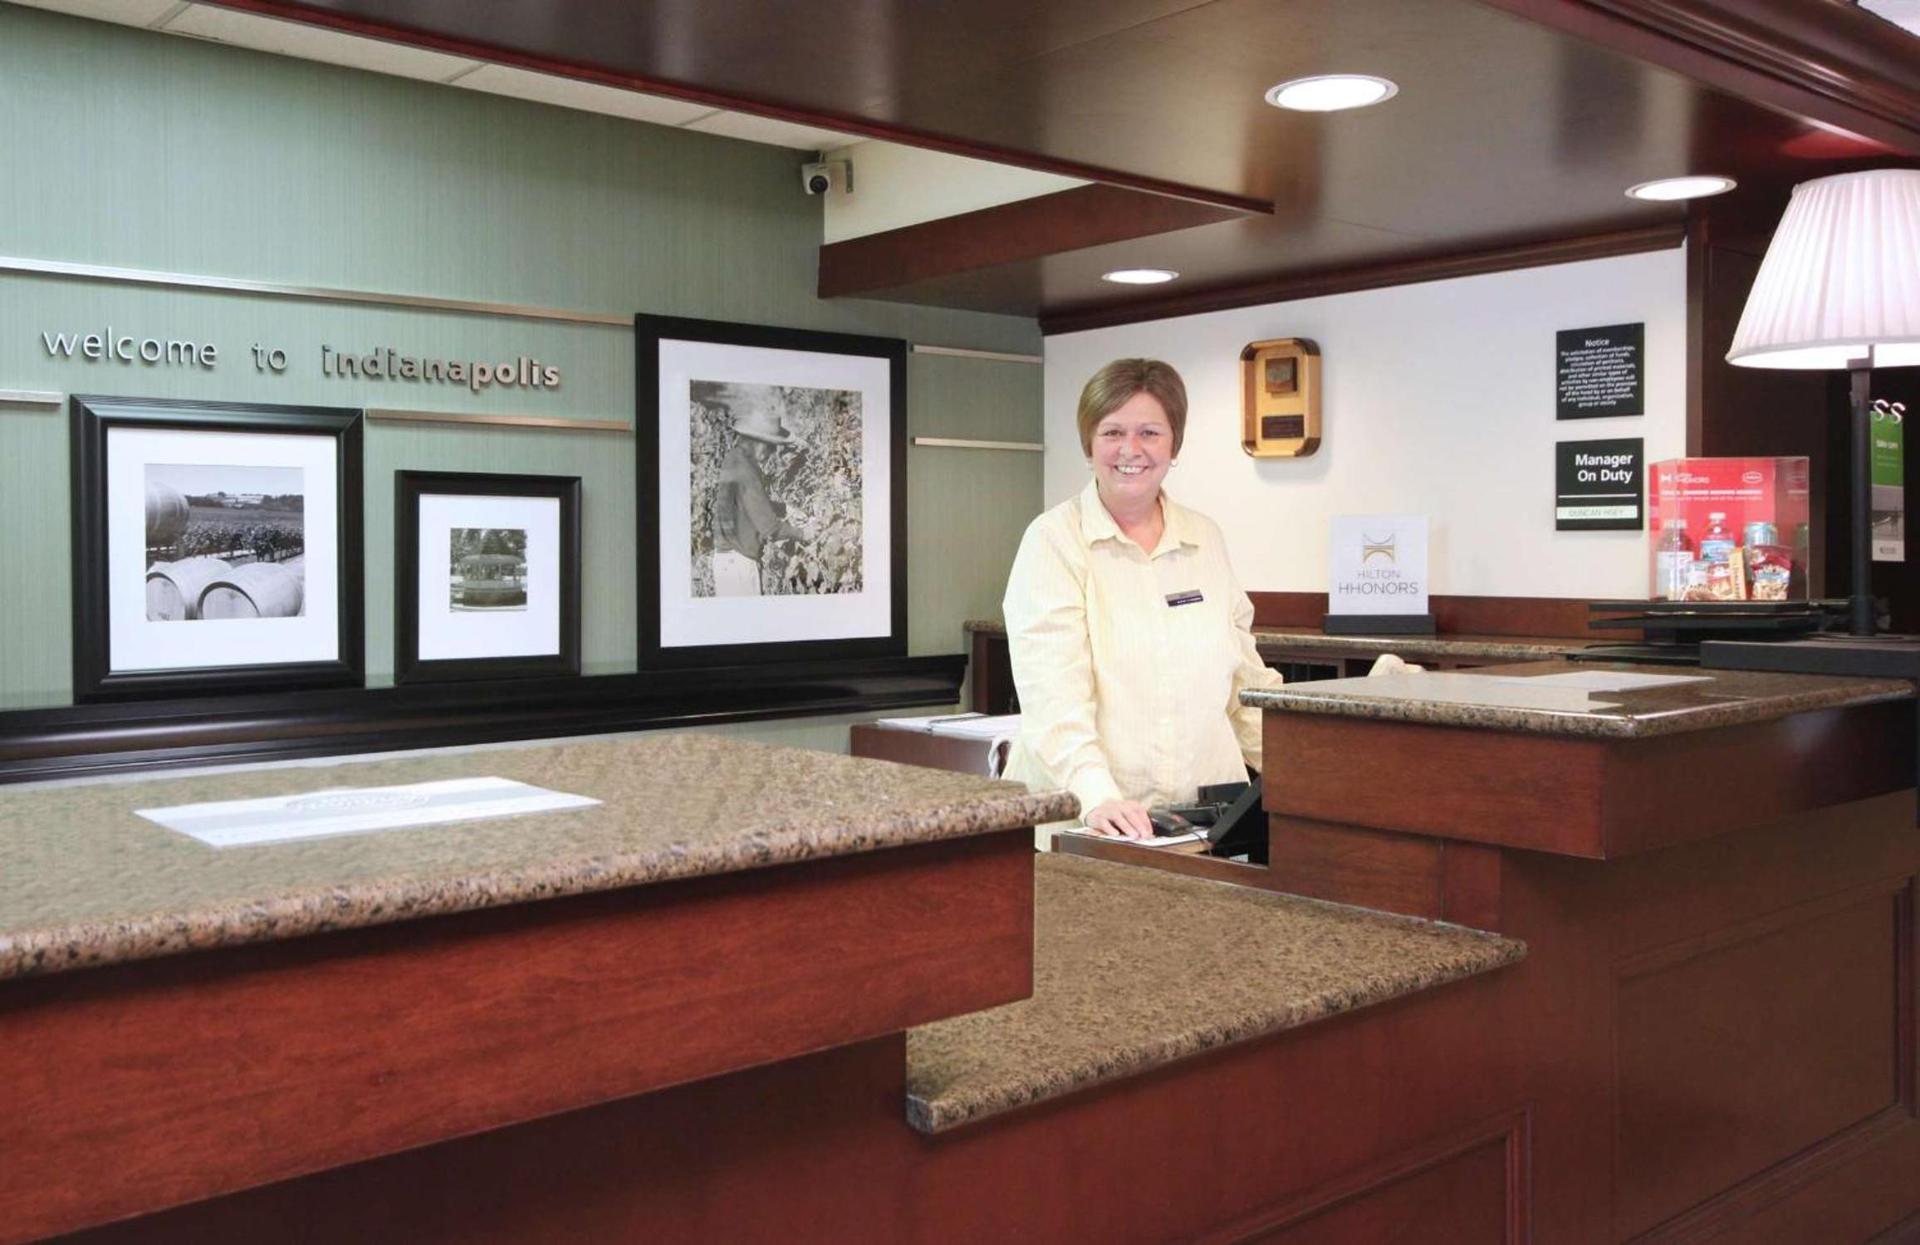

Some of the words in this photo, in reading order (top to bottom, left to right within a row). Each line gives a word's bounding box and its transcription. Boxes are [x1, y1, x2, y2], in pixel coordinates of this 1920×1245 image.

[1585, 339, 1610, 347] Notice
[42, 327, 219, 369] welcome
[252, 343, 287, 373] to
[322, 345, 561, 392] indianapolis
[1575, 454, 1633, 467] Manager
[1578, 469, 1596, 482] On
[1601, 469, 1632, 484] Duty
[1357, 569, 1401, 579] HILTON
[1338, 582, 1418, 594] HHONORS
